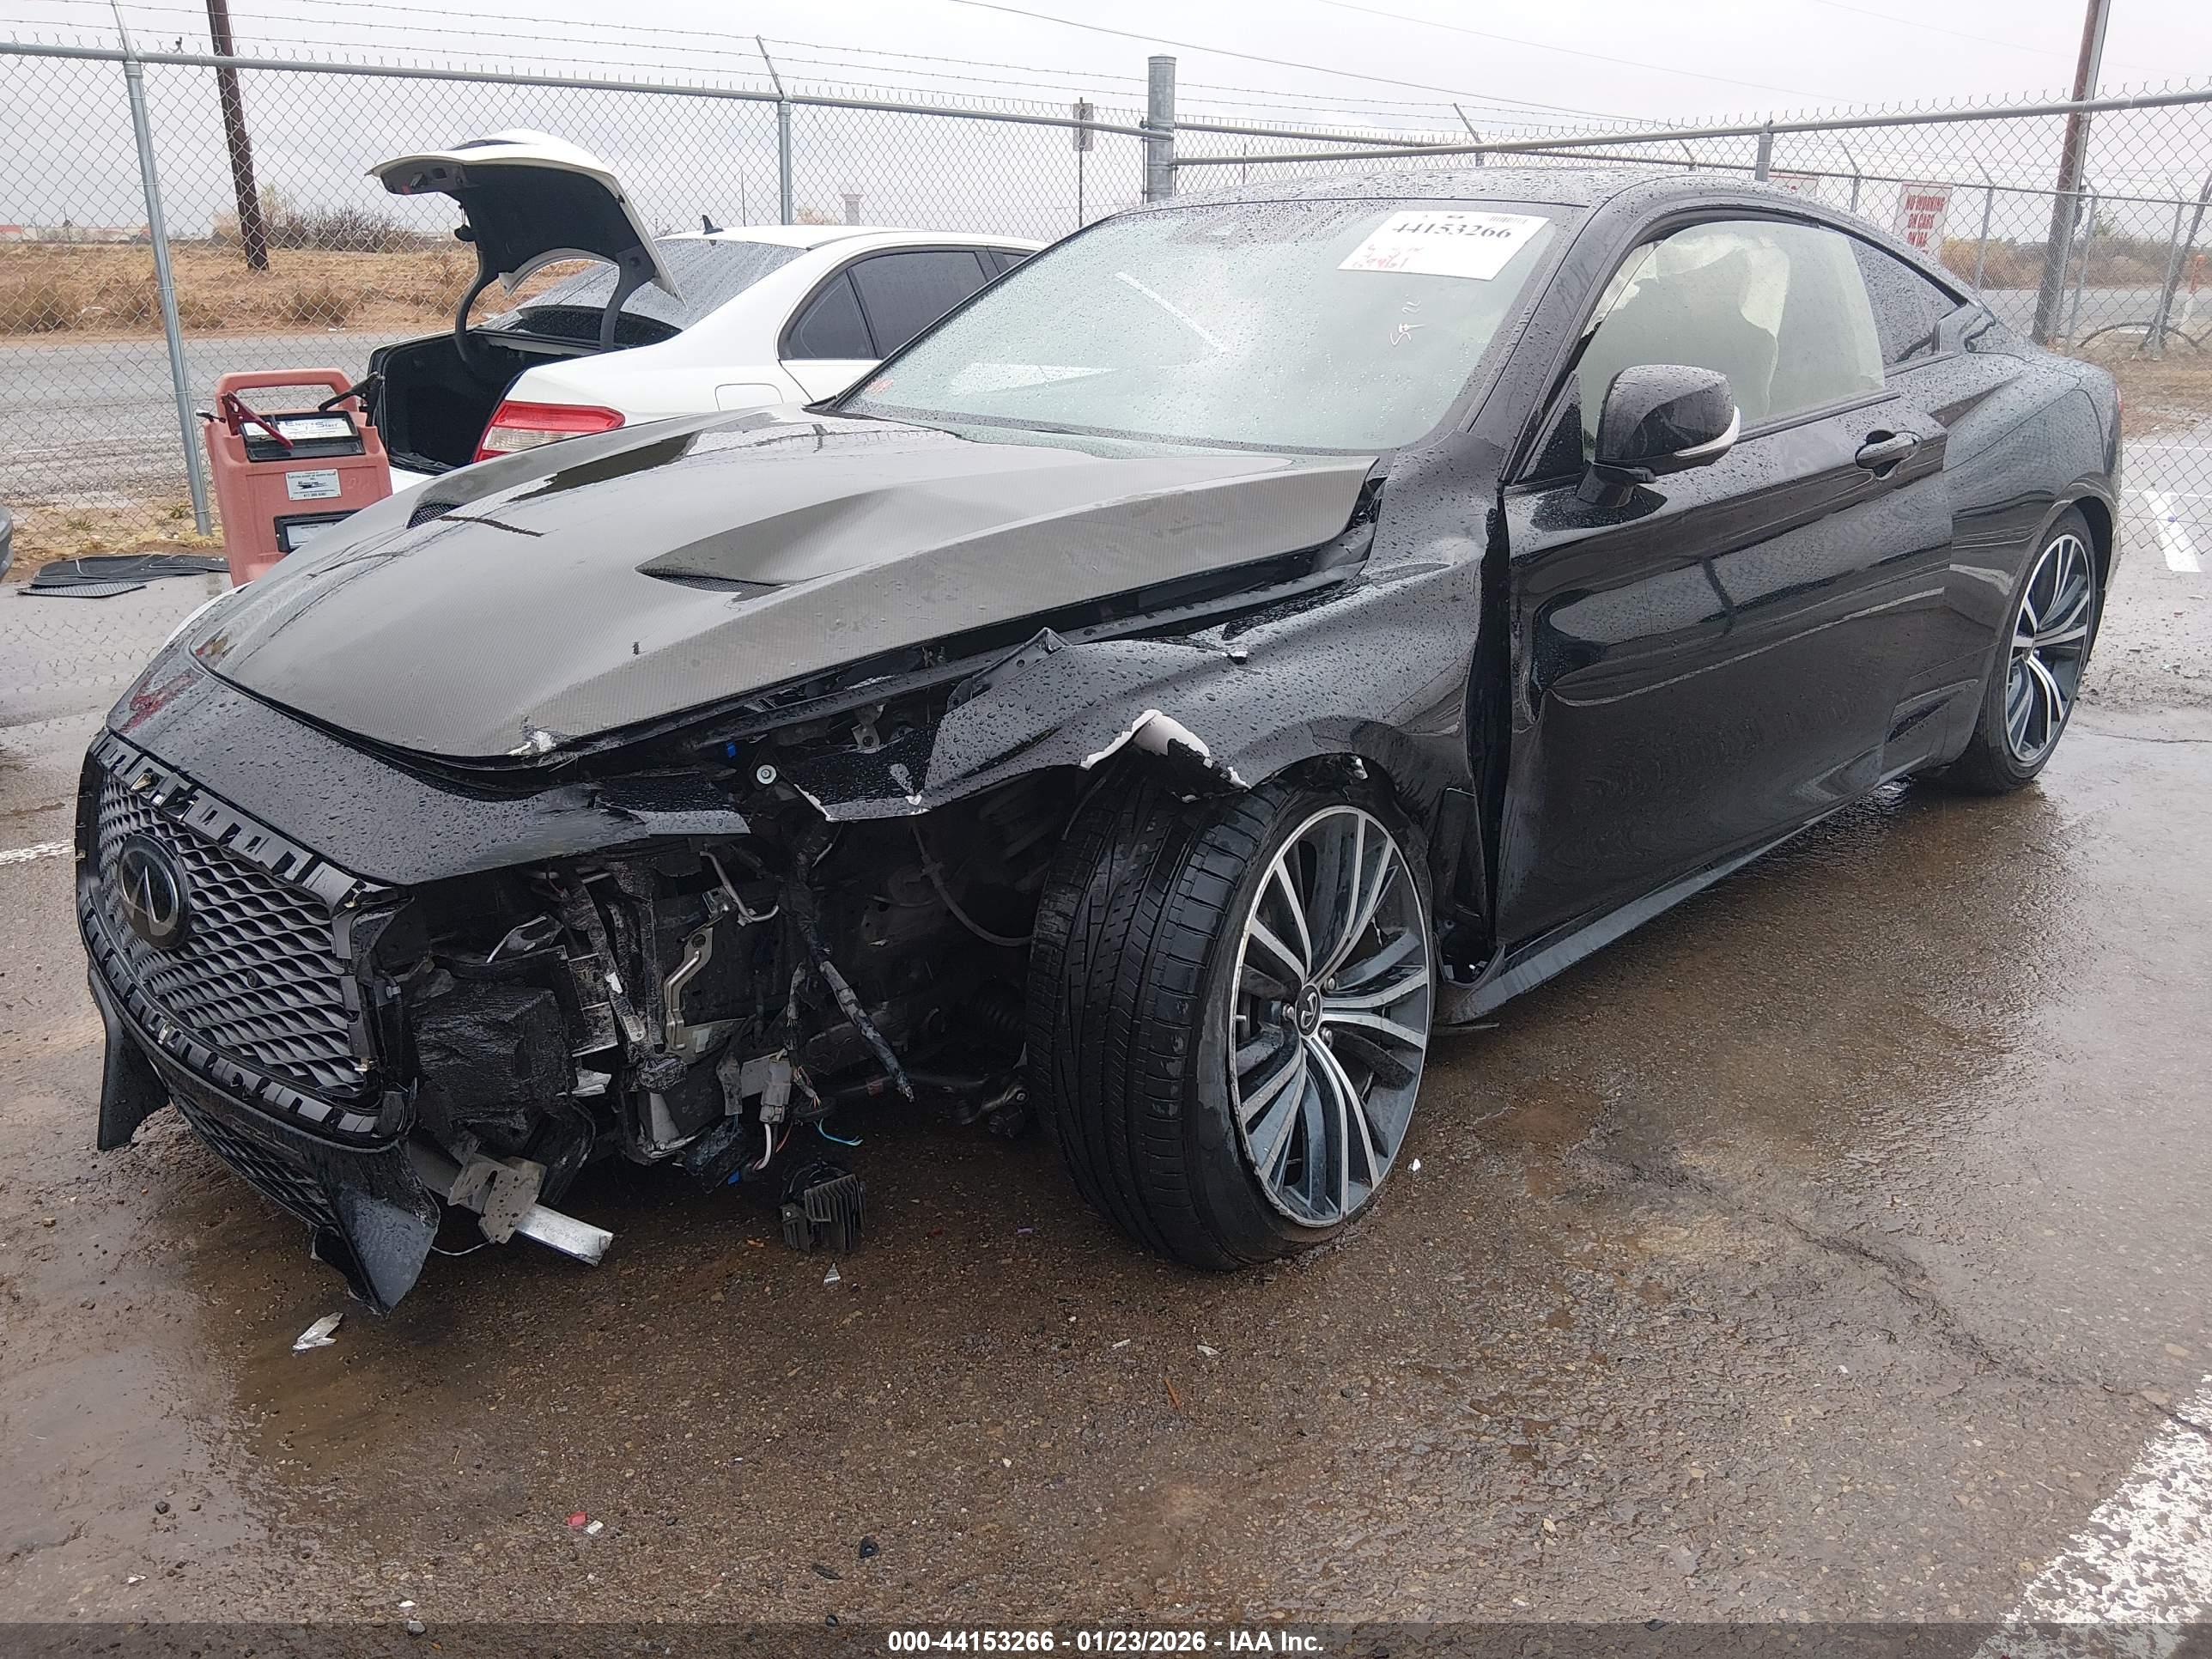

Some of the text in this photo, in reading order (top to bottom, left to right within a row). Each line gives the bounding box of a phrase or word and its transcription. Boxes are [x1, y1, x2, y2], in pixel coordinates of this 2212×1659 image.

[1906, 195, 1945, 212] NO WORKING
[1917, 213, 1935, 229] CARS
[1392, 222, 1512, 239] 44153266
